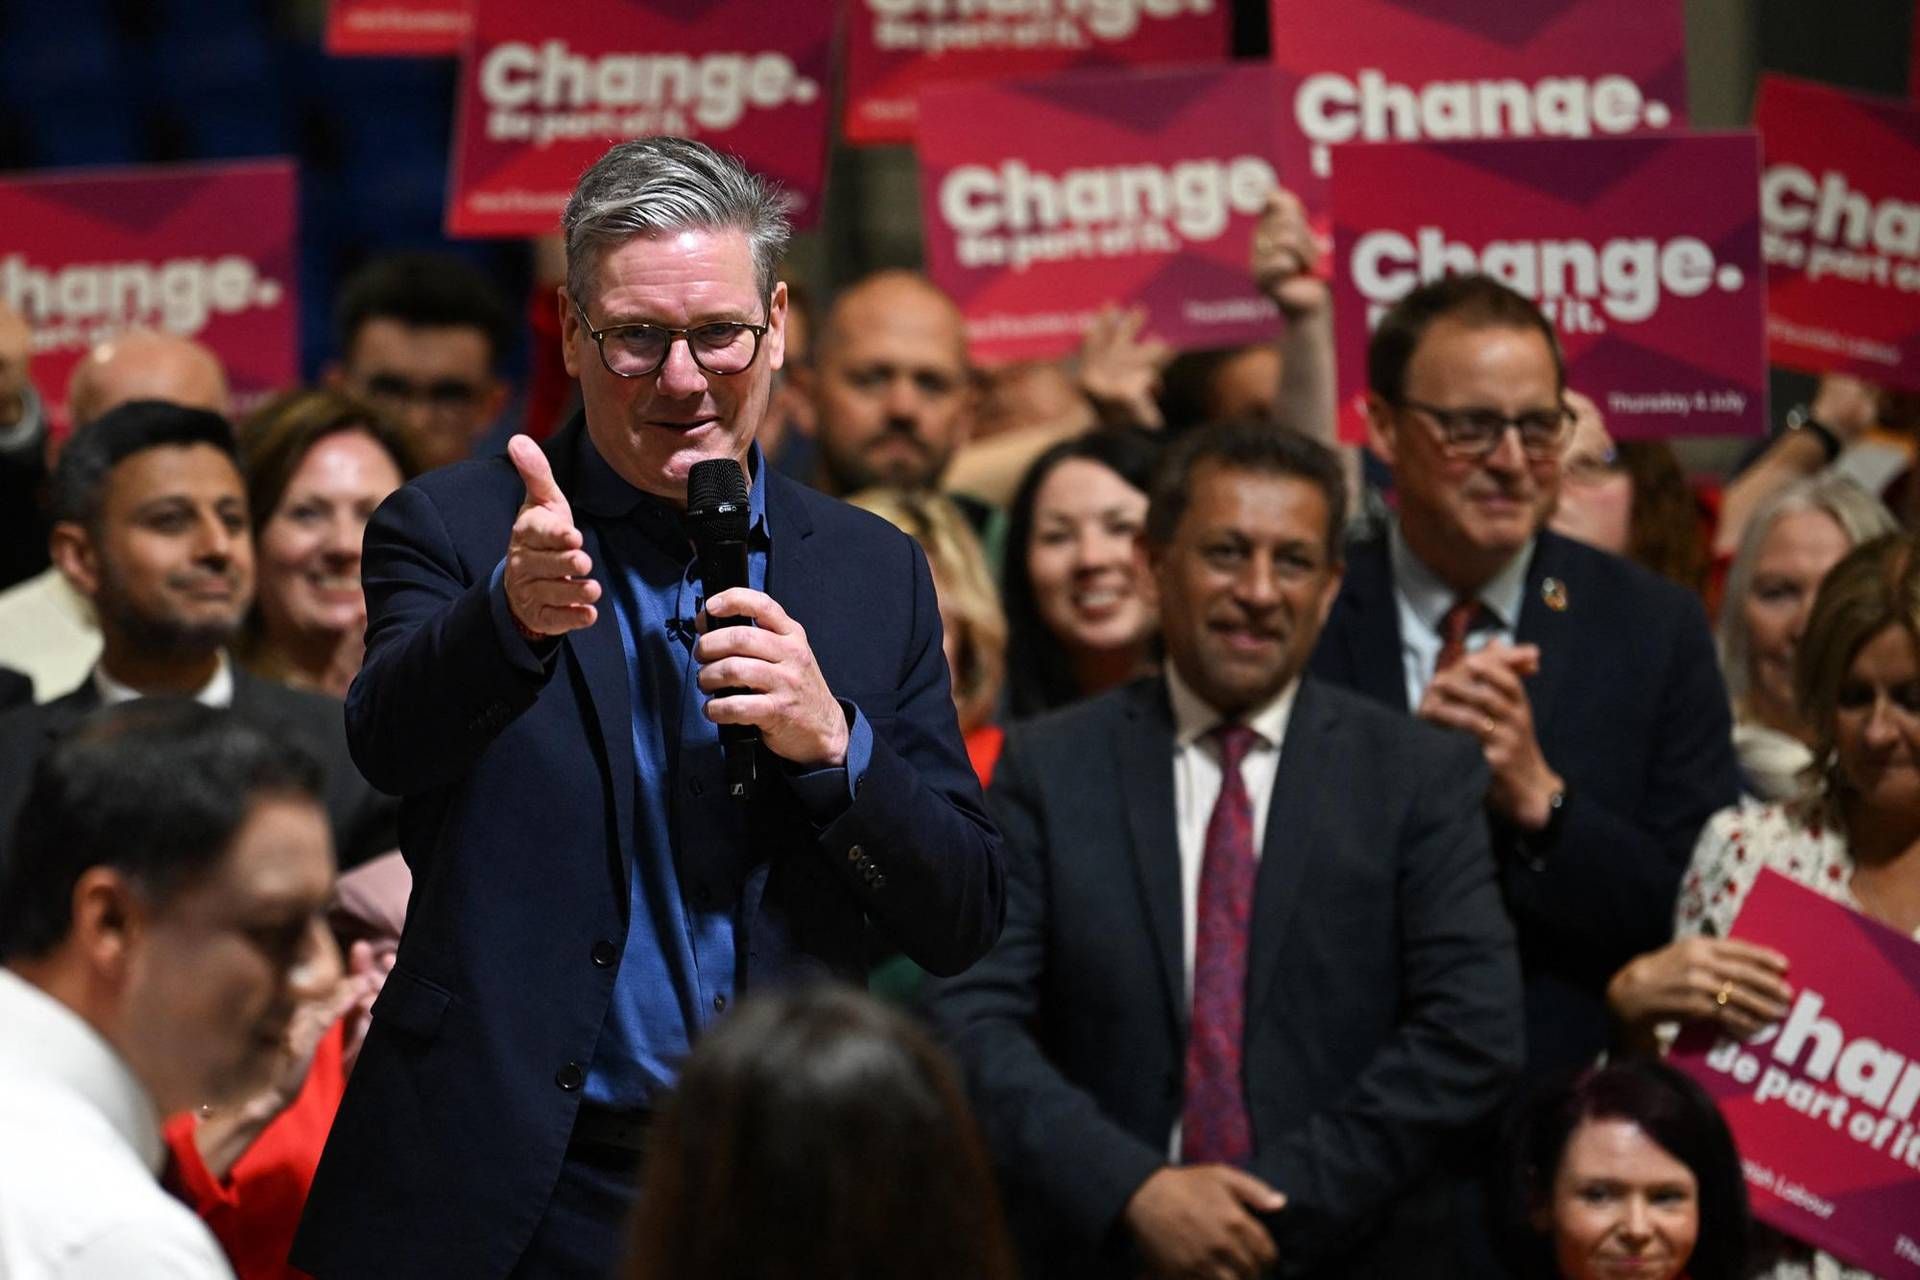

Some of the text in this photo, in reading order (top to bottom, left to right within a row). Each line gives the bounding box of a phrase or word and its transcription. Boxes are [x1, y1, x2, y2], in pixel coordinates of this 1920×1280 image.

[481, 39, 818, 131] Change.
[0, 254, 283, 336] hange.
[1350, 225, 1744, 322] Change.
[1748, 987, 1920, 1122] ha
[1753, 1065, 1849, 1131] part
[1847, 1110, 1897, 1151] of
[1774, 1174, 1836, 1221] Labour
